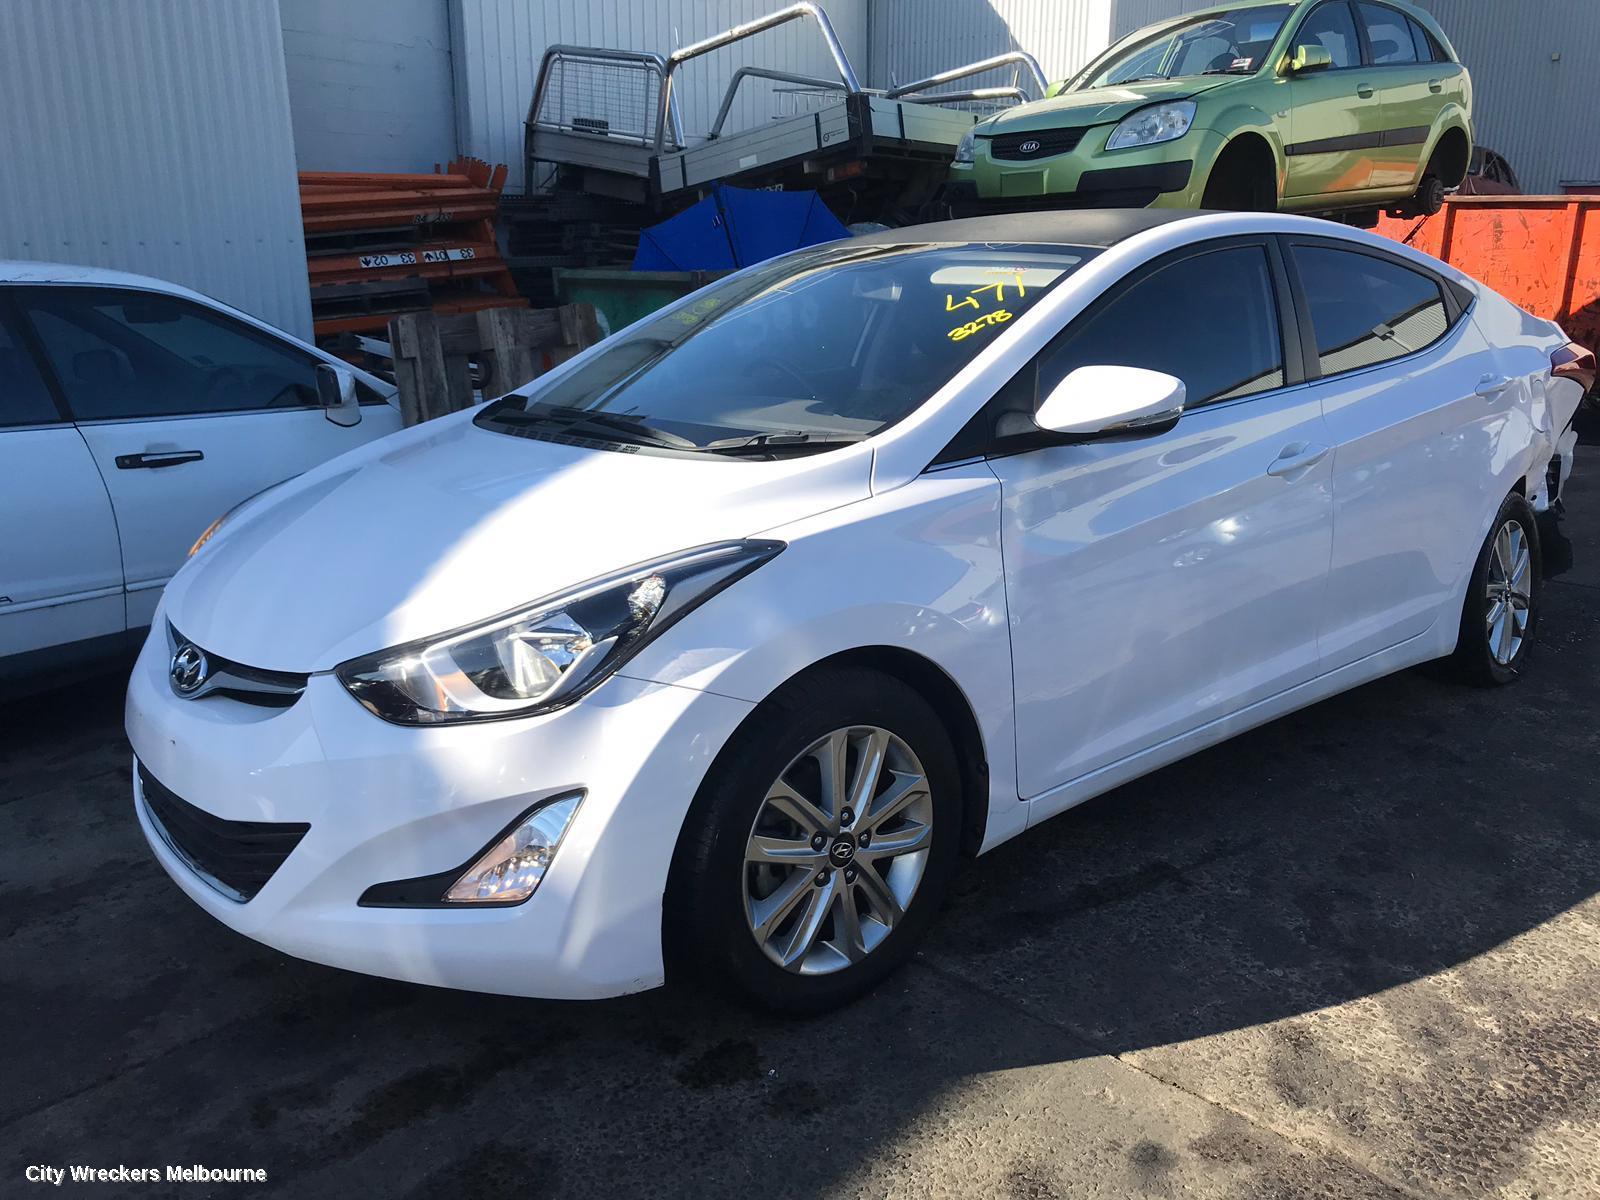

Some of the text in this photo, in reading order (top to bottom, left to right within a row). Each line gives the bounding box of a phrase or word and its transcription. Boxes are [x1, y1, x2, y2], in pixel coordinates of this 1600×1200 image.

[1022, 142, 1036, 151] KIA
[372, 252, 416, 266] 33 02
[434, 247, 474, 261] 33 01
[945, 274, 1026, 312] 471
[947, 309, 1013, 341] 3278
